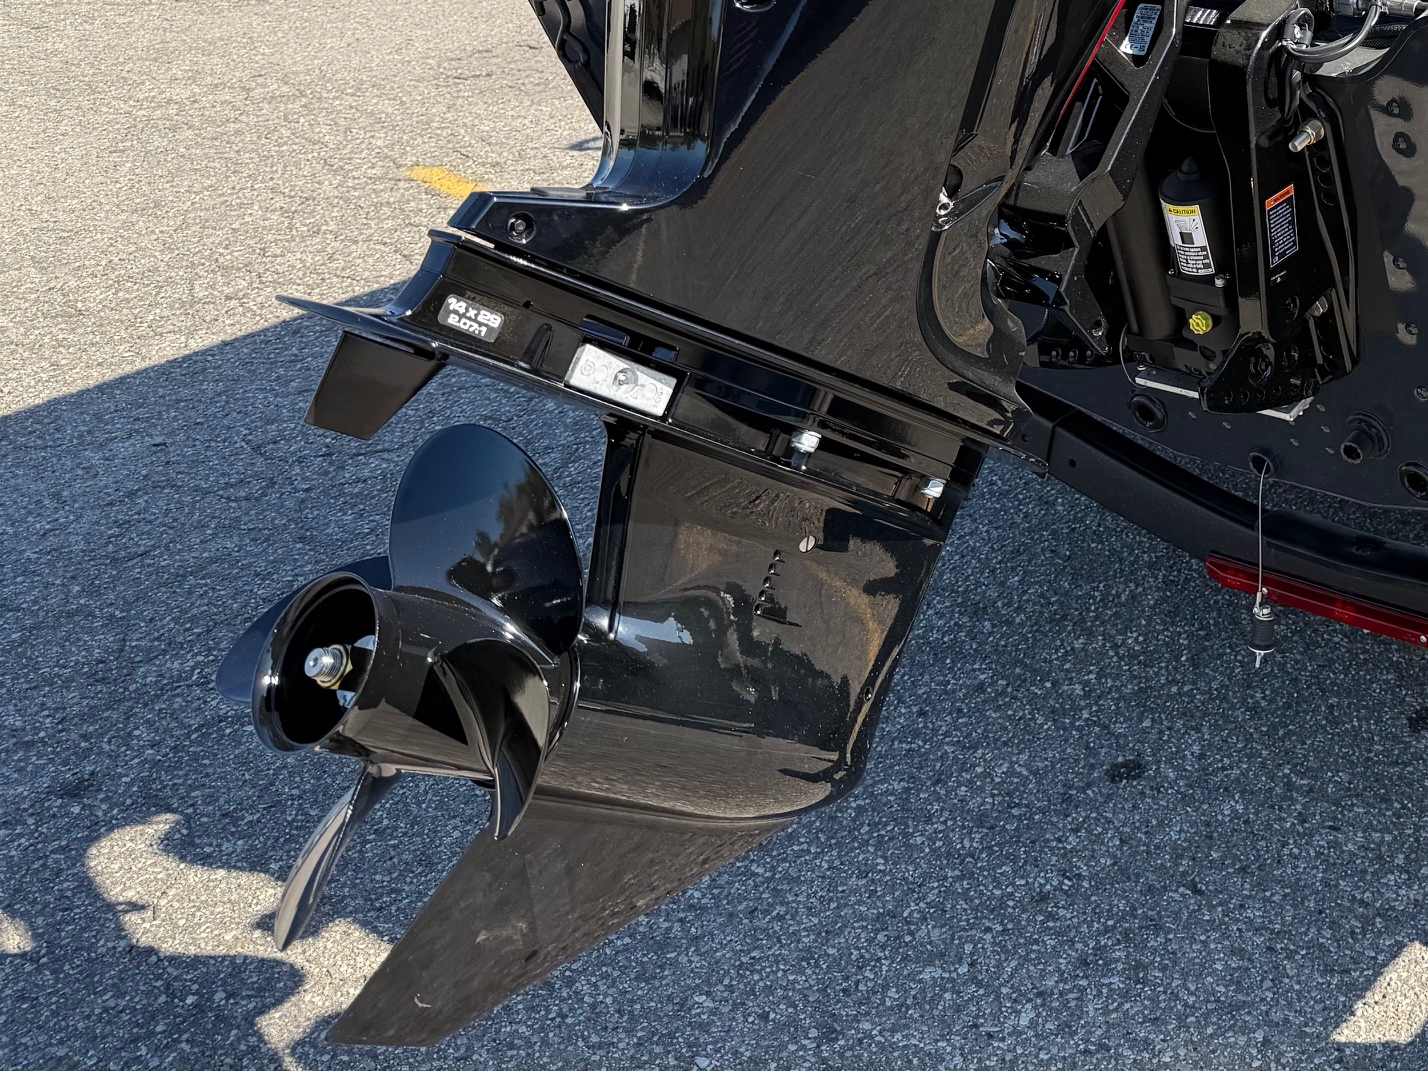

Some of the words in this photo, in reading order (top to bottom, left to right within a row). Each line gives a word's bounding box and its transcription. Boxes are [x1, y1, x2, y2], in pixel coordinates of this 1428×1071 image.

[447, 297, 467, 315] 14
[465, 307, 477, 320] x
[477, 309, 502, 328] 29
[447, 313, 488, 337] 2.07:1
